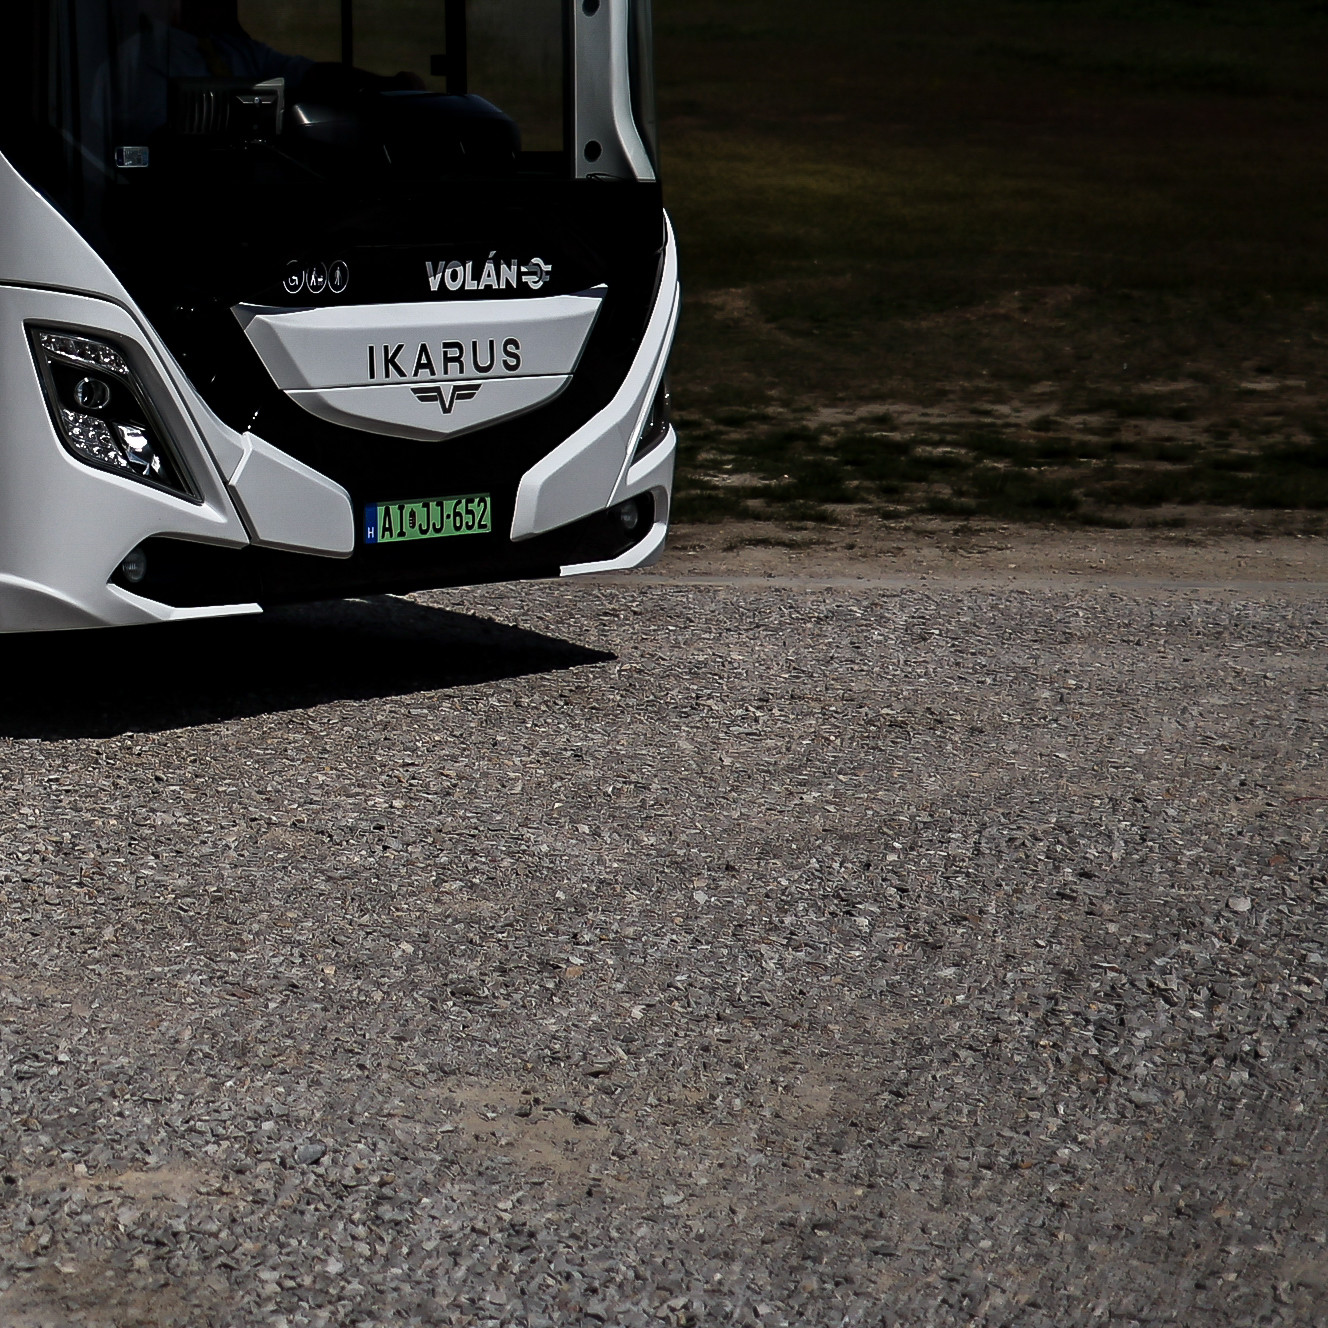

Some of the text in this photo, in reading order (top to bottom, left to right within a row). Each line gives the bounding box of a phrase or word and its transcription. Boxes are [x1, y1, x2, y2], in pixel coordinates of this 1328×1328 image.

[425, 250, 518, 292] VOLÁN
[368, 336, 522, 380] IKARUS
[367, 526, 375, 539] H
